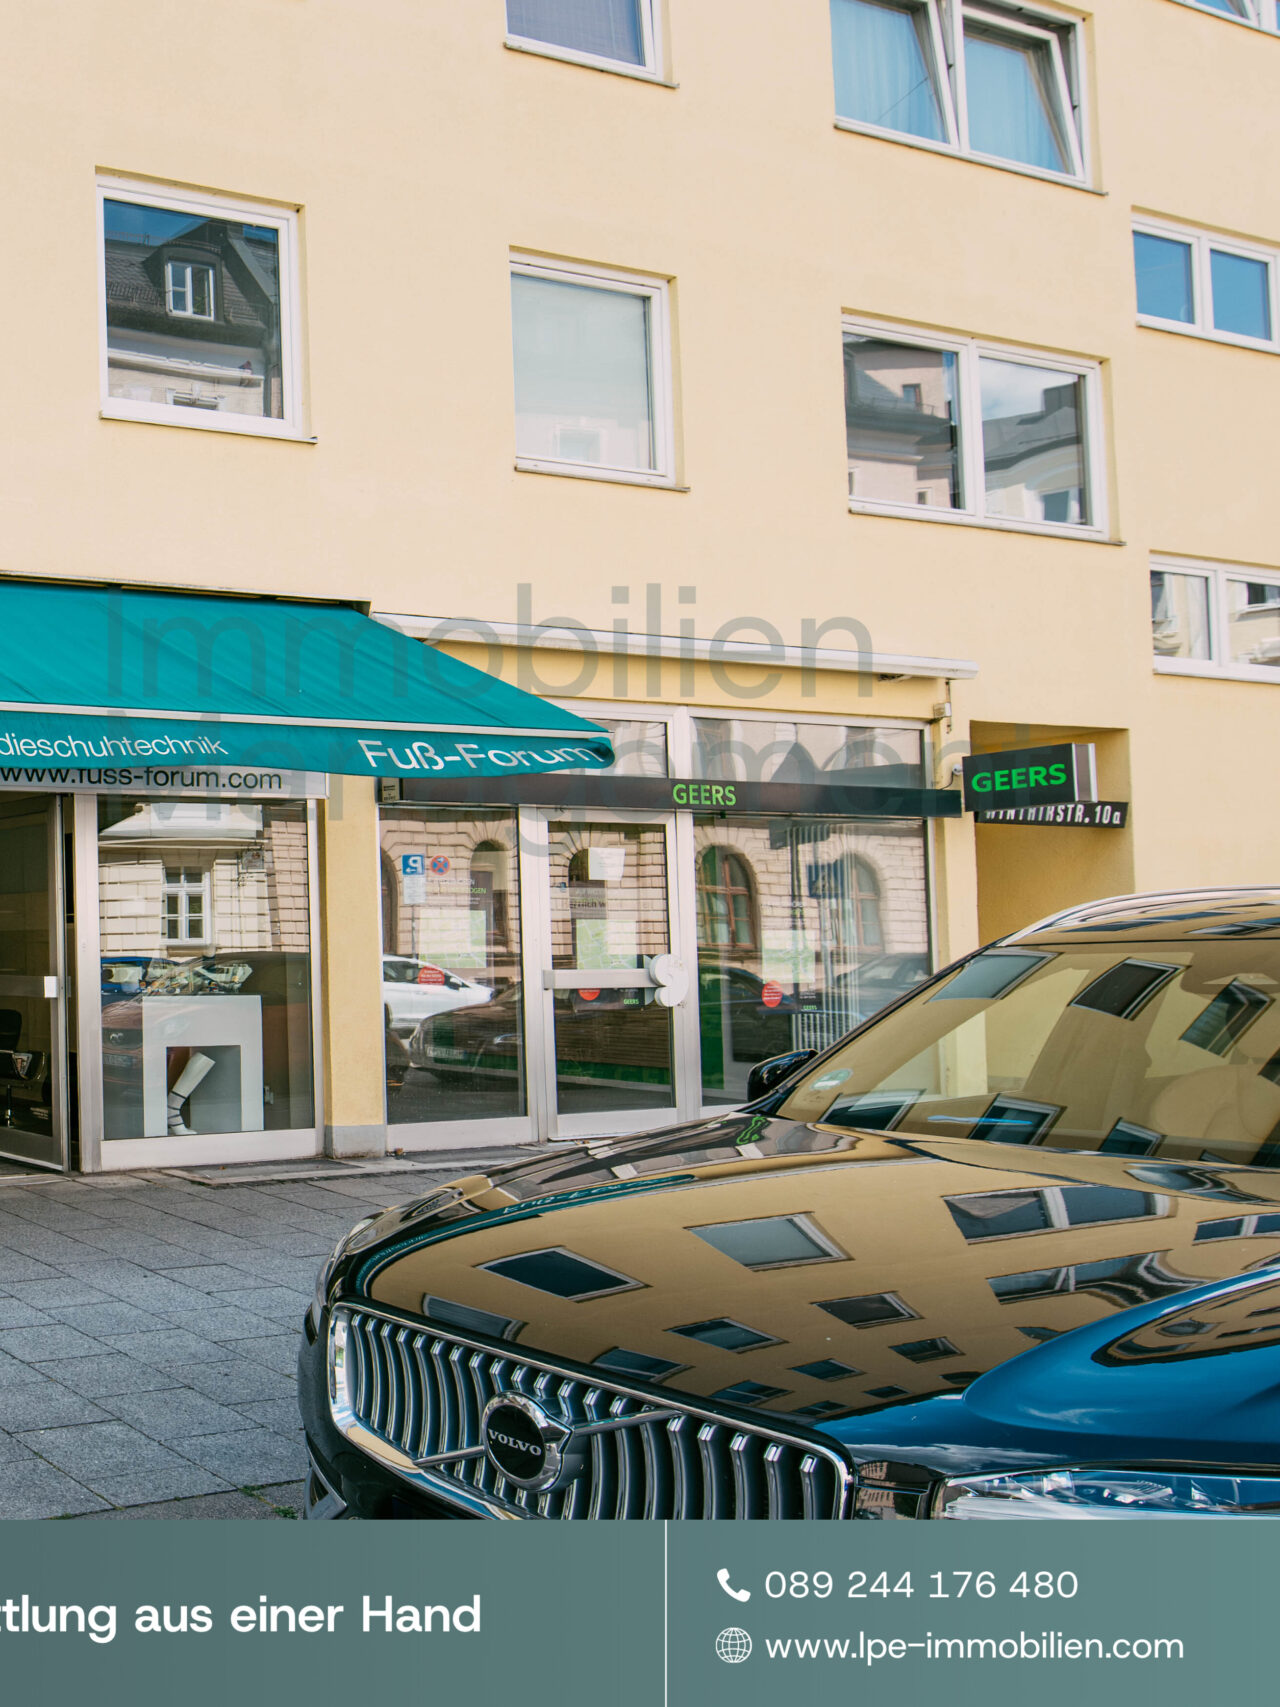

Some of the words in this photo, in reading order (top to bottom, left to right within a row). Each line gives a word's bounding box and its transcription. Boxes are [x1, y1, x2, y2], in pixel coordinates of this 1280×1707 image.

[357, 739, 607, 771] Fuß-Forum
[970, 762, 1068, 793] GEERS
[672, 783, 737, 807] GEERS
[1094, 804, 1121, 825] 10a
[487, 1427, 543, 1457] VOLVO
